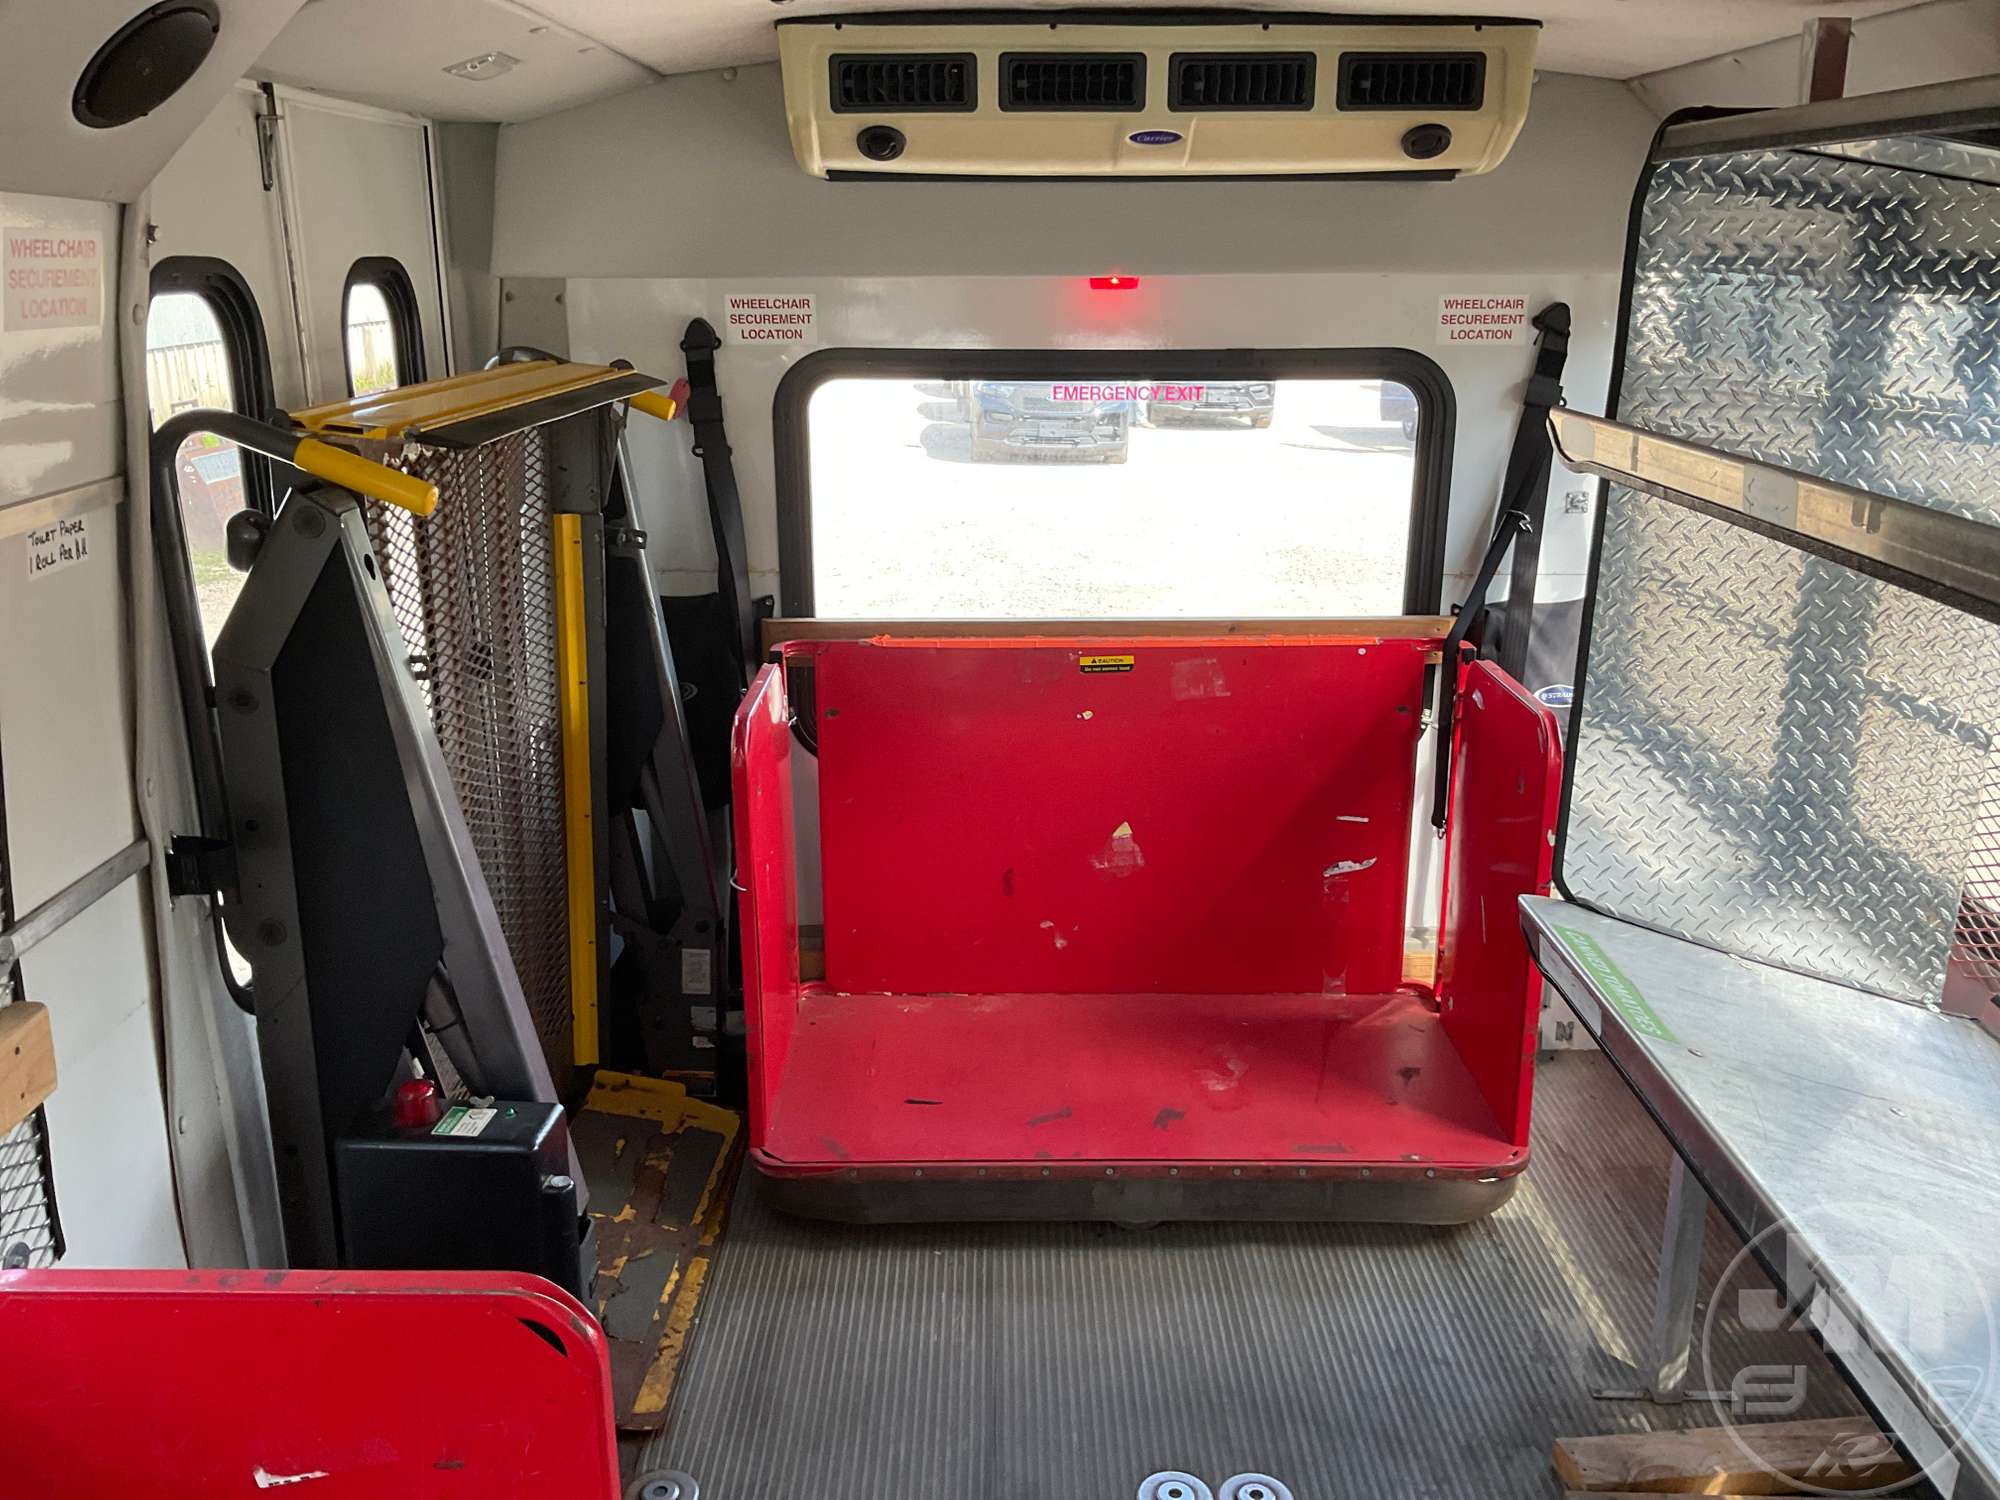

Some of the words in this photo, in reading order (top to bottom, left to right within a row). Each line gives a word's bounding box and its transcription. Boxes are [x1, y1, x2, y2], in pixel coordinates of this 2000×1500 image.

[1136, 133, 1175, 142] Carrier
[9, 239, 96, 258] WHEELCHAIR
[21, 297, 88, 319] LOCATION
[730, 298, 810, 309] WHEELCHAIR
[1444, 299, 1525, 310] WHEELCHAIR
[729, 313, 812, 325] SECUREMENT
[1441, 314, 1525, 325] SECUREMENT
[741, 328, 803, 340] LOCATION
[1450, 329, 1513, 340] LOCATION
[1052, 385, 1162, 401] EMERGENCY
[1164, 385, 1204, 401] EXIT
[1600, 973, 1663, 1036] TOMATOES
